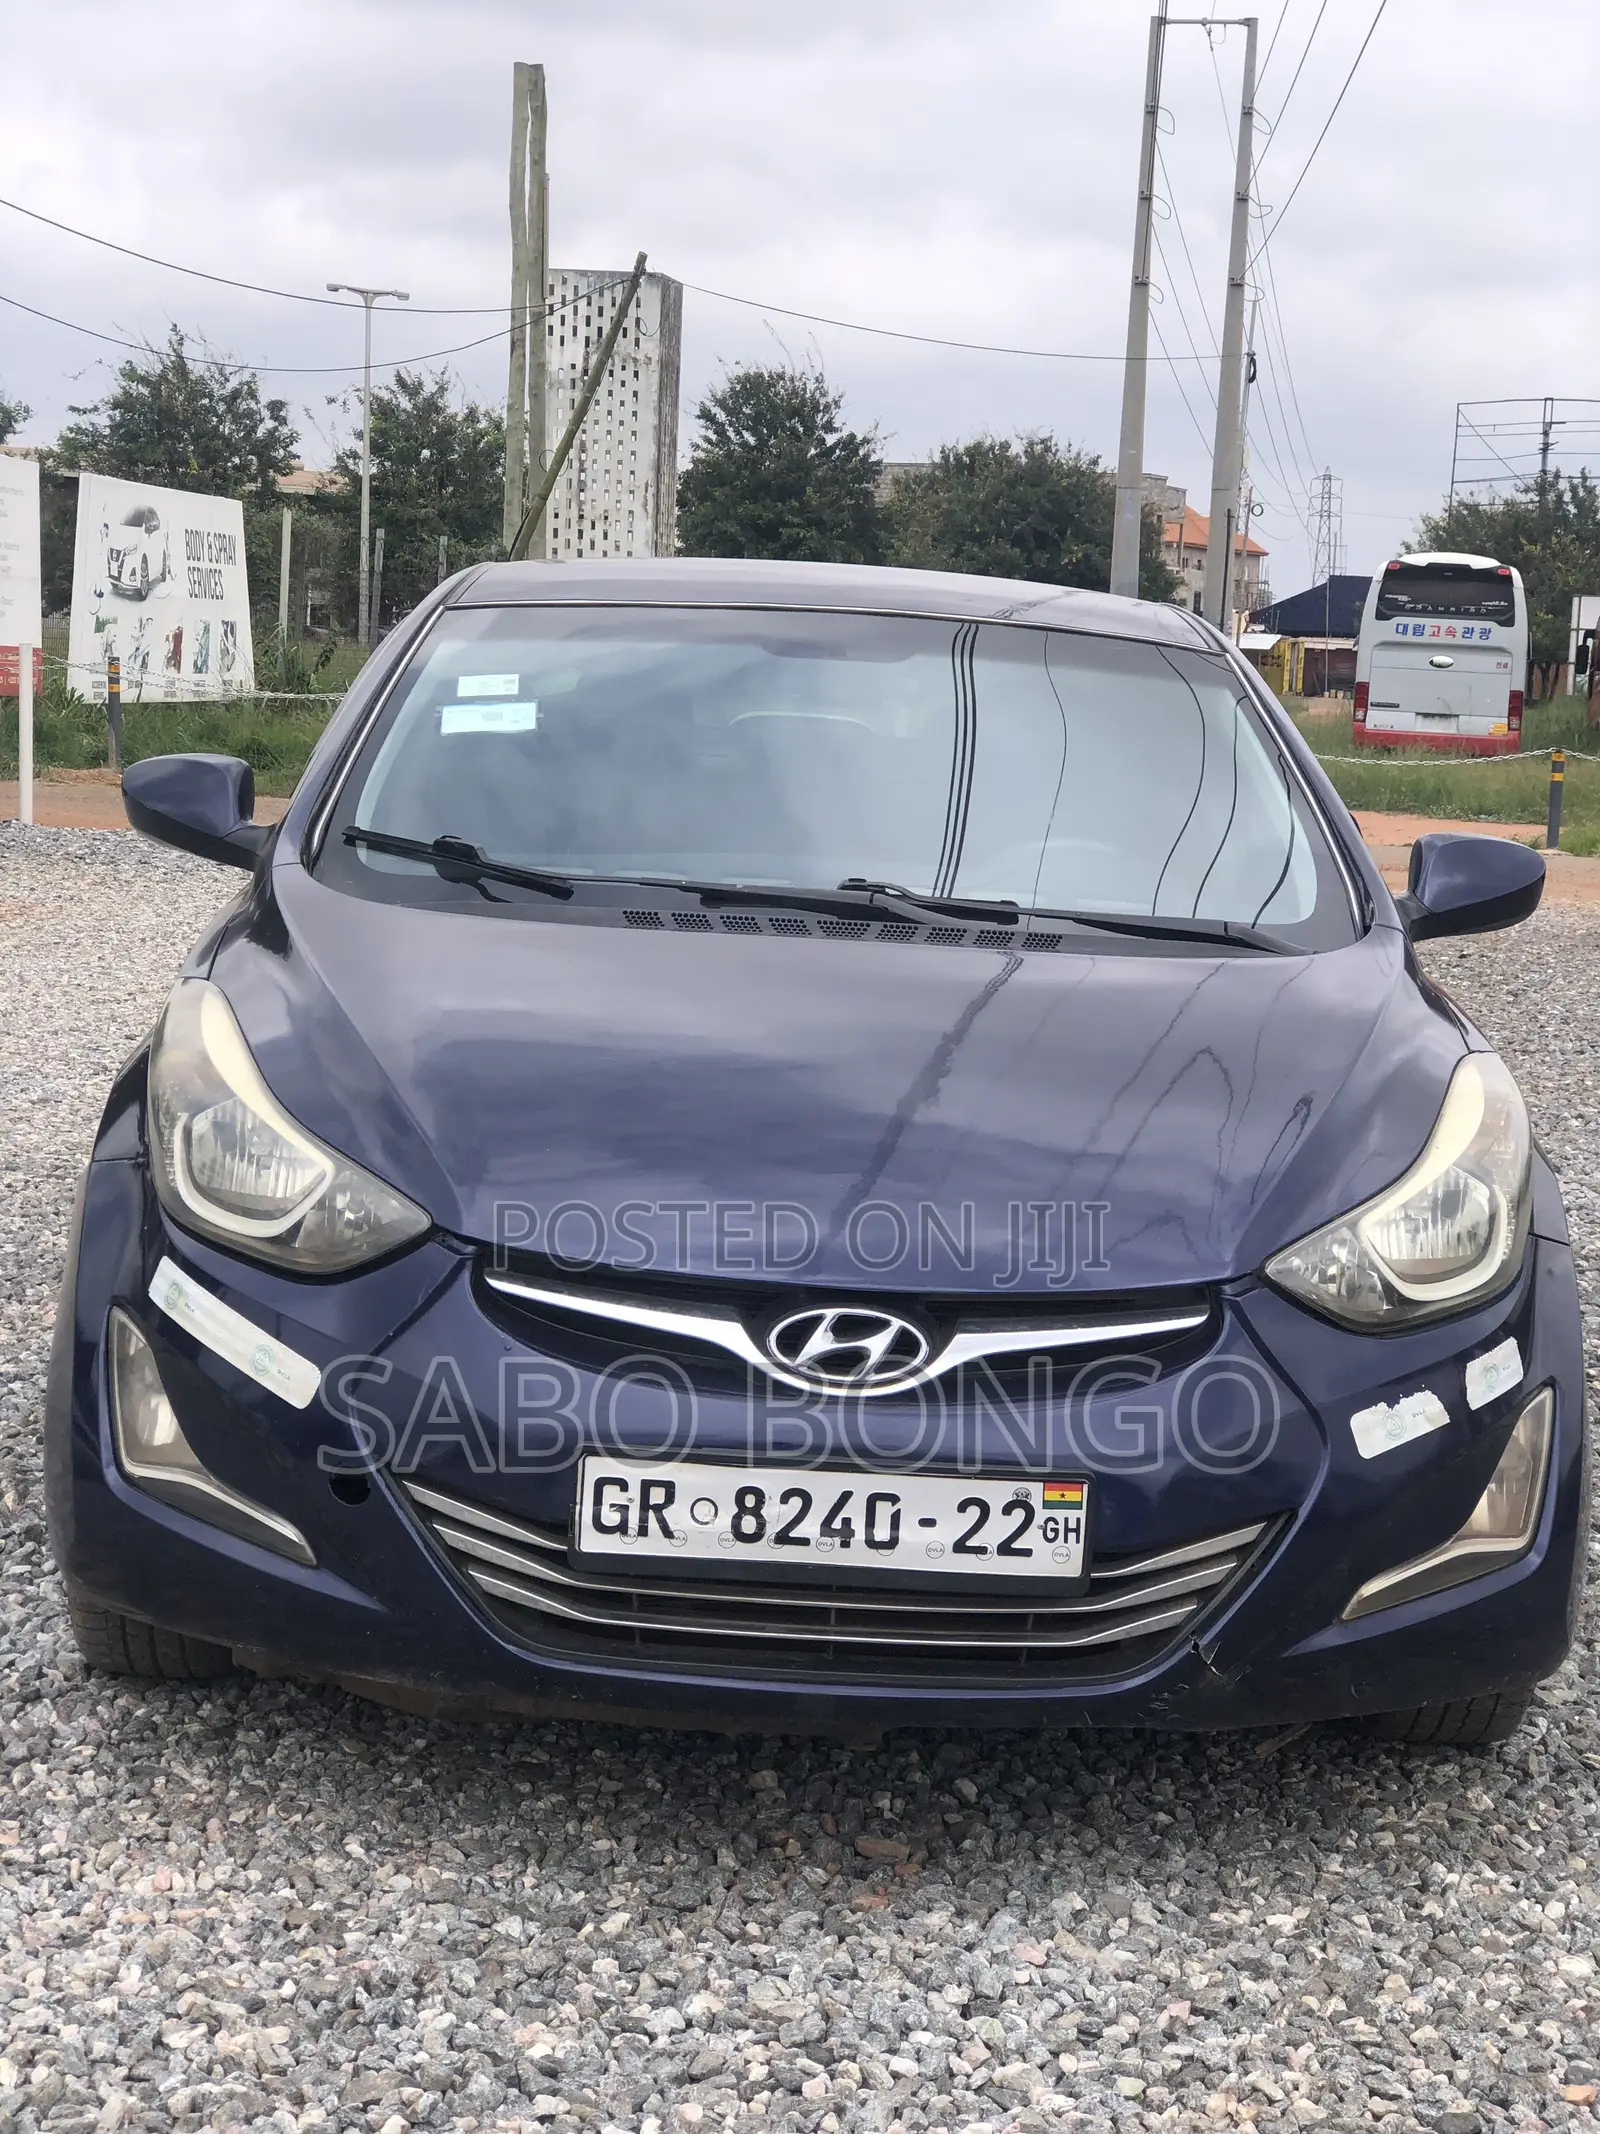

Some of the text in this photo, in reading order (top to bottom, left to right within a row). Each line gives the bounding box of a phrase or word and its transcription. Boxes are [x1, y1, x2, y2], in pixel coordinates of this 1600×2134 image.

[184, 528, 237, 566] BODY & SPRAY
[187, 565, 224, 601] SERVICES
[592, 1477, 676, 1539] GR
[1041, 1516, 1081, 1545] GH
